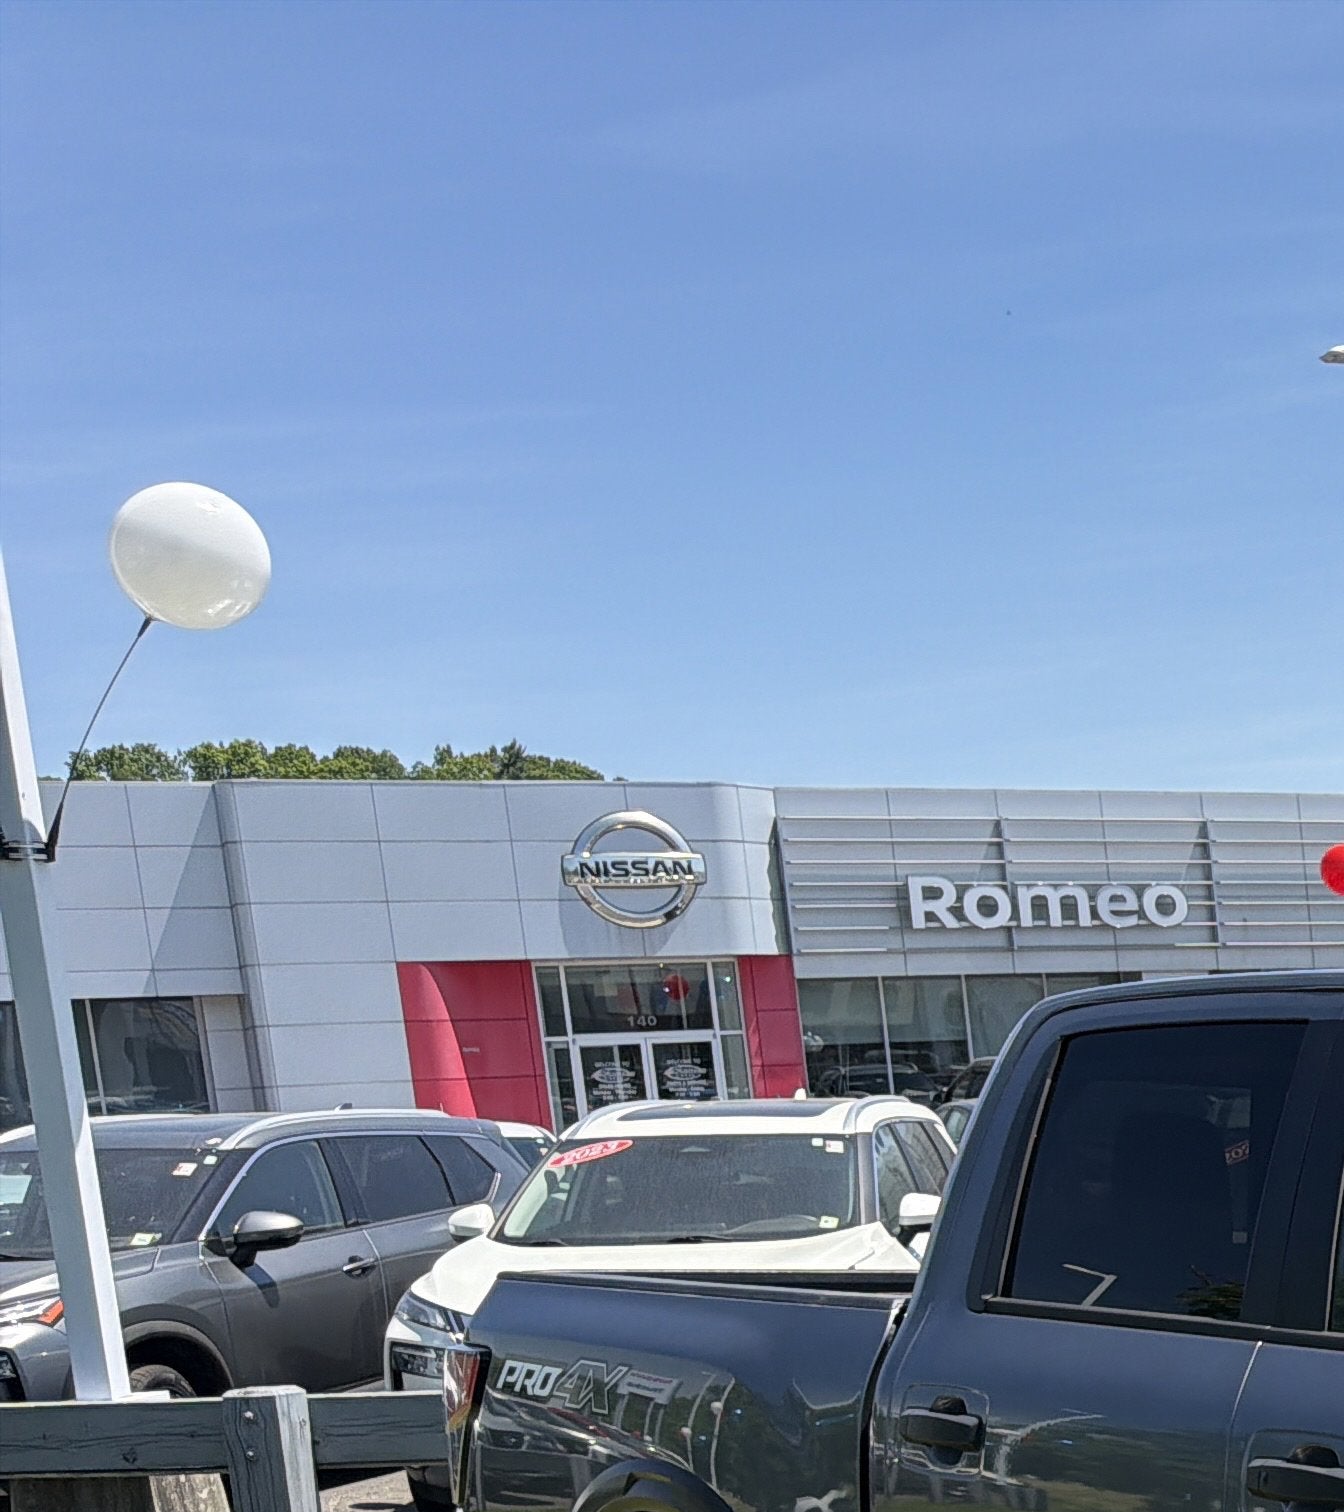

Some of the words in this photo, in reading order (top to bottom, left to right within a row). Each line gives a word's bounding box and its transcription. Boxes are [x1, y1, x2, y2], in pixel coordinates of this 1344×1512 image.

[578, 860, 694, 878] NISSAN
[907, 875, 1188, 930] Romeo
[627, 1015, 657, 1027] 140
